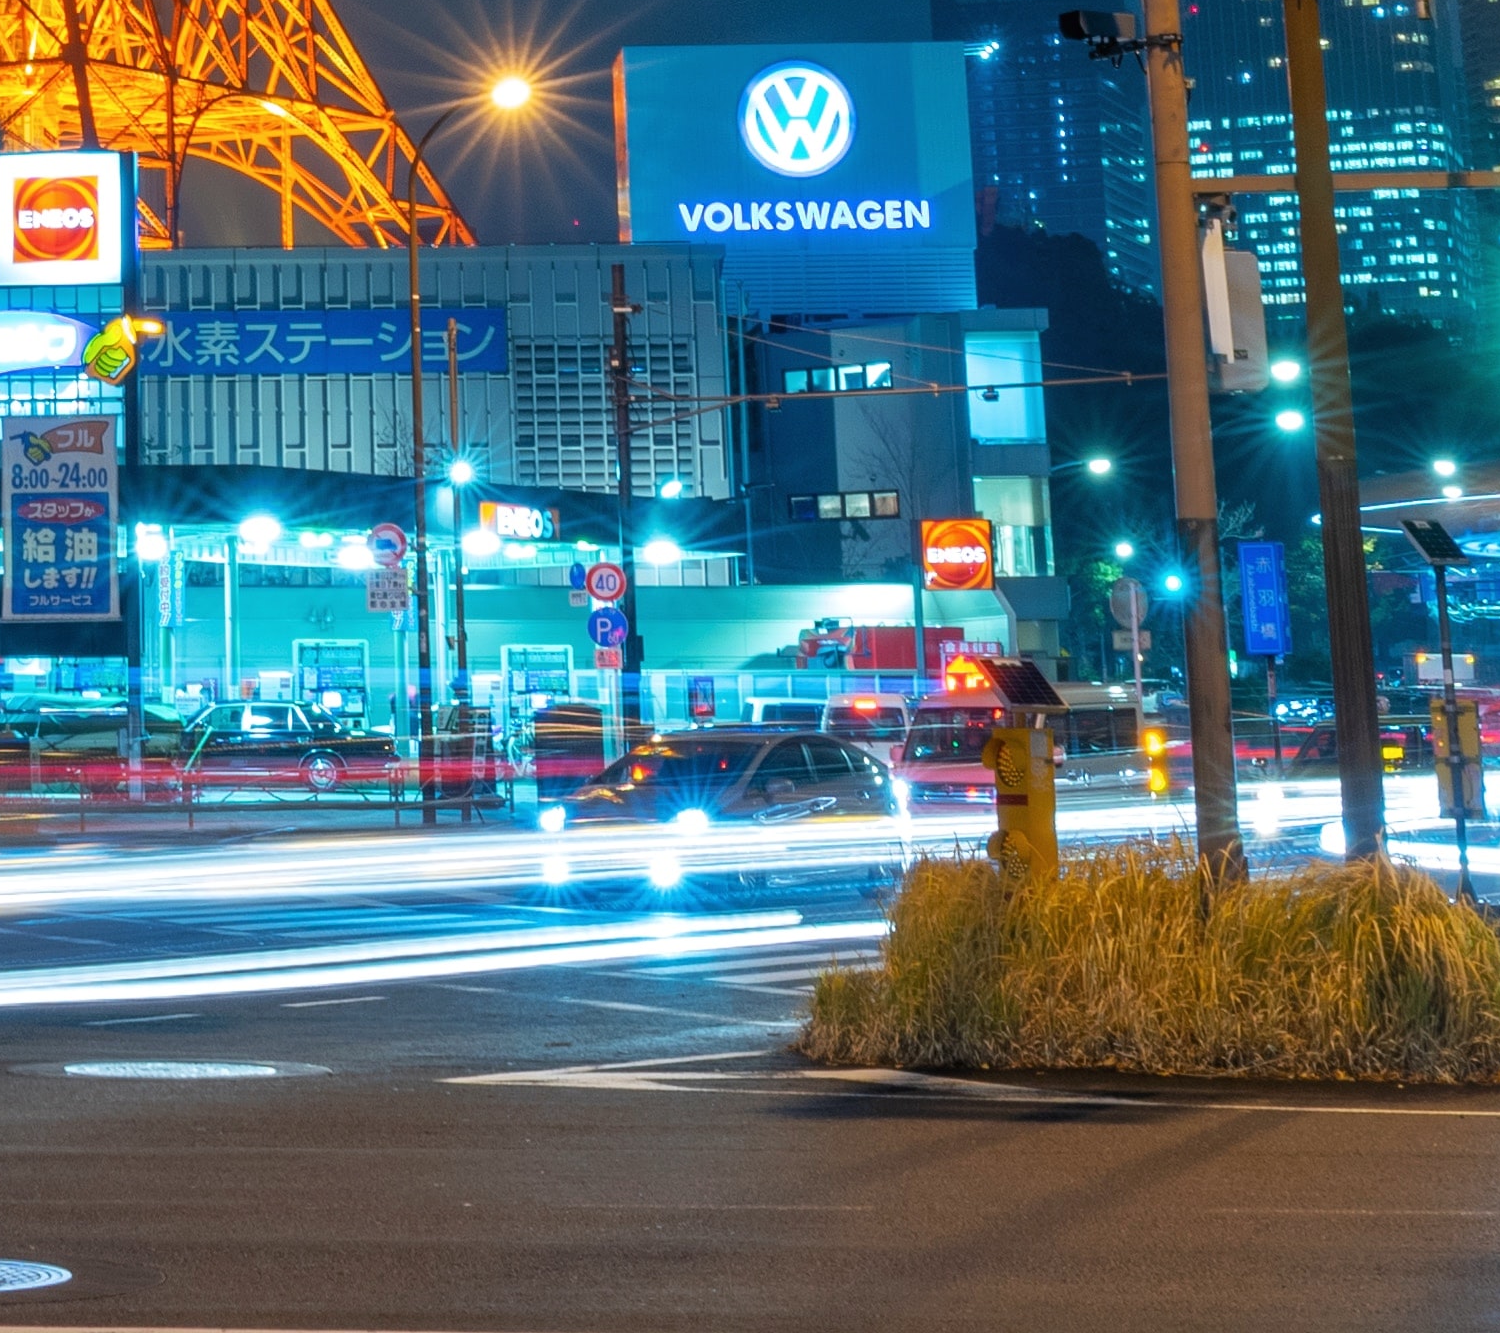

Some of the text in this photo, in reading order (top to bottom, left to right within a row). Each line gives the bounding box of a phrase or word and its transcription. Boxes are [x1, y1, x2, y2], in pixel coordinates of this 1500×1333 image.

[18, 207, 95, 230] ENEOS
[678, 200, 930, 232] VOLKSWAGEN
[148, 321, 496, 367] 水素ステーション
[56, 431, 95, 449] フル
[27, 502, 95, 519] スタッフが
[496, 505, 554, 539] ENEOS
[22, 527, 98, 563] 給油
[926, 546, 987, 564] ENEOS
[595, 573, 617, 592] 40
[29, 594, 92, 607] フルサービス
[1255, 556, 1277, 640] 赤羽橋
[596, 617, 612, 643] P
